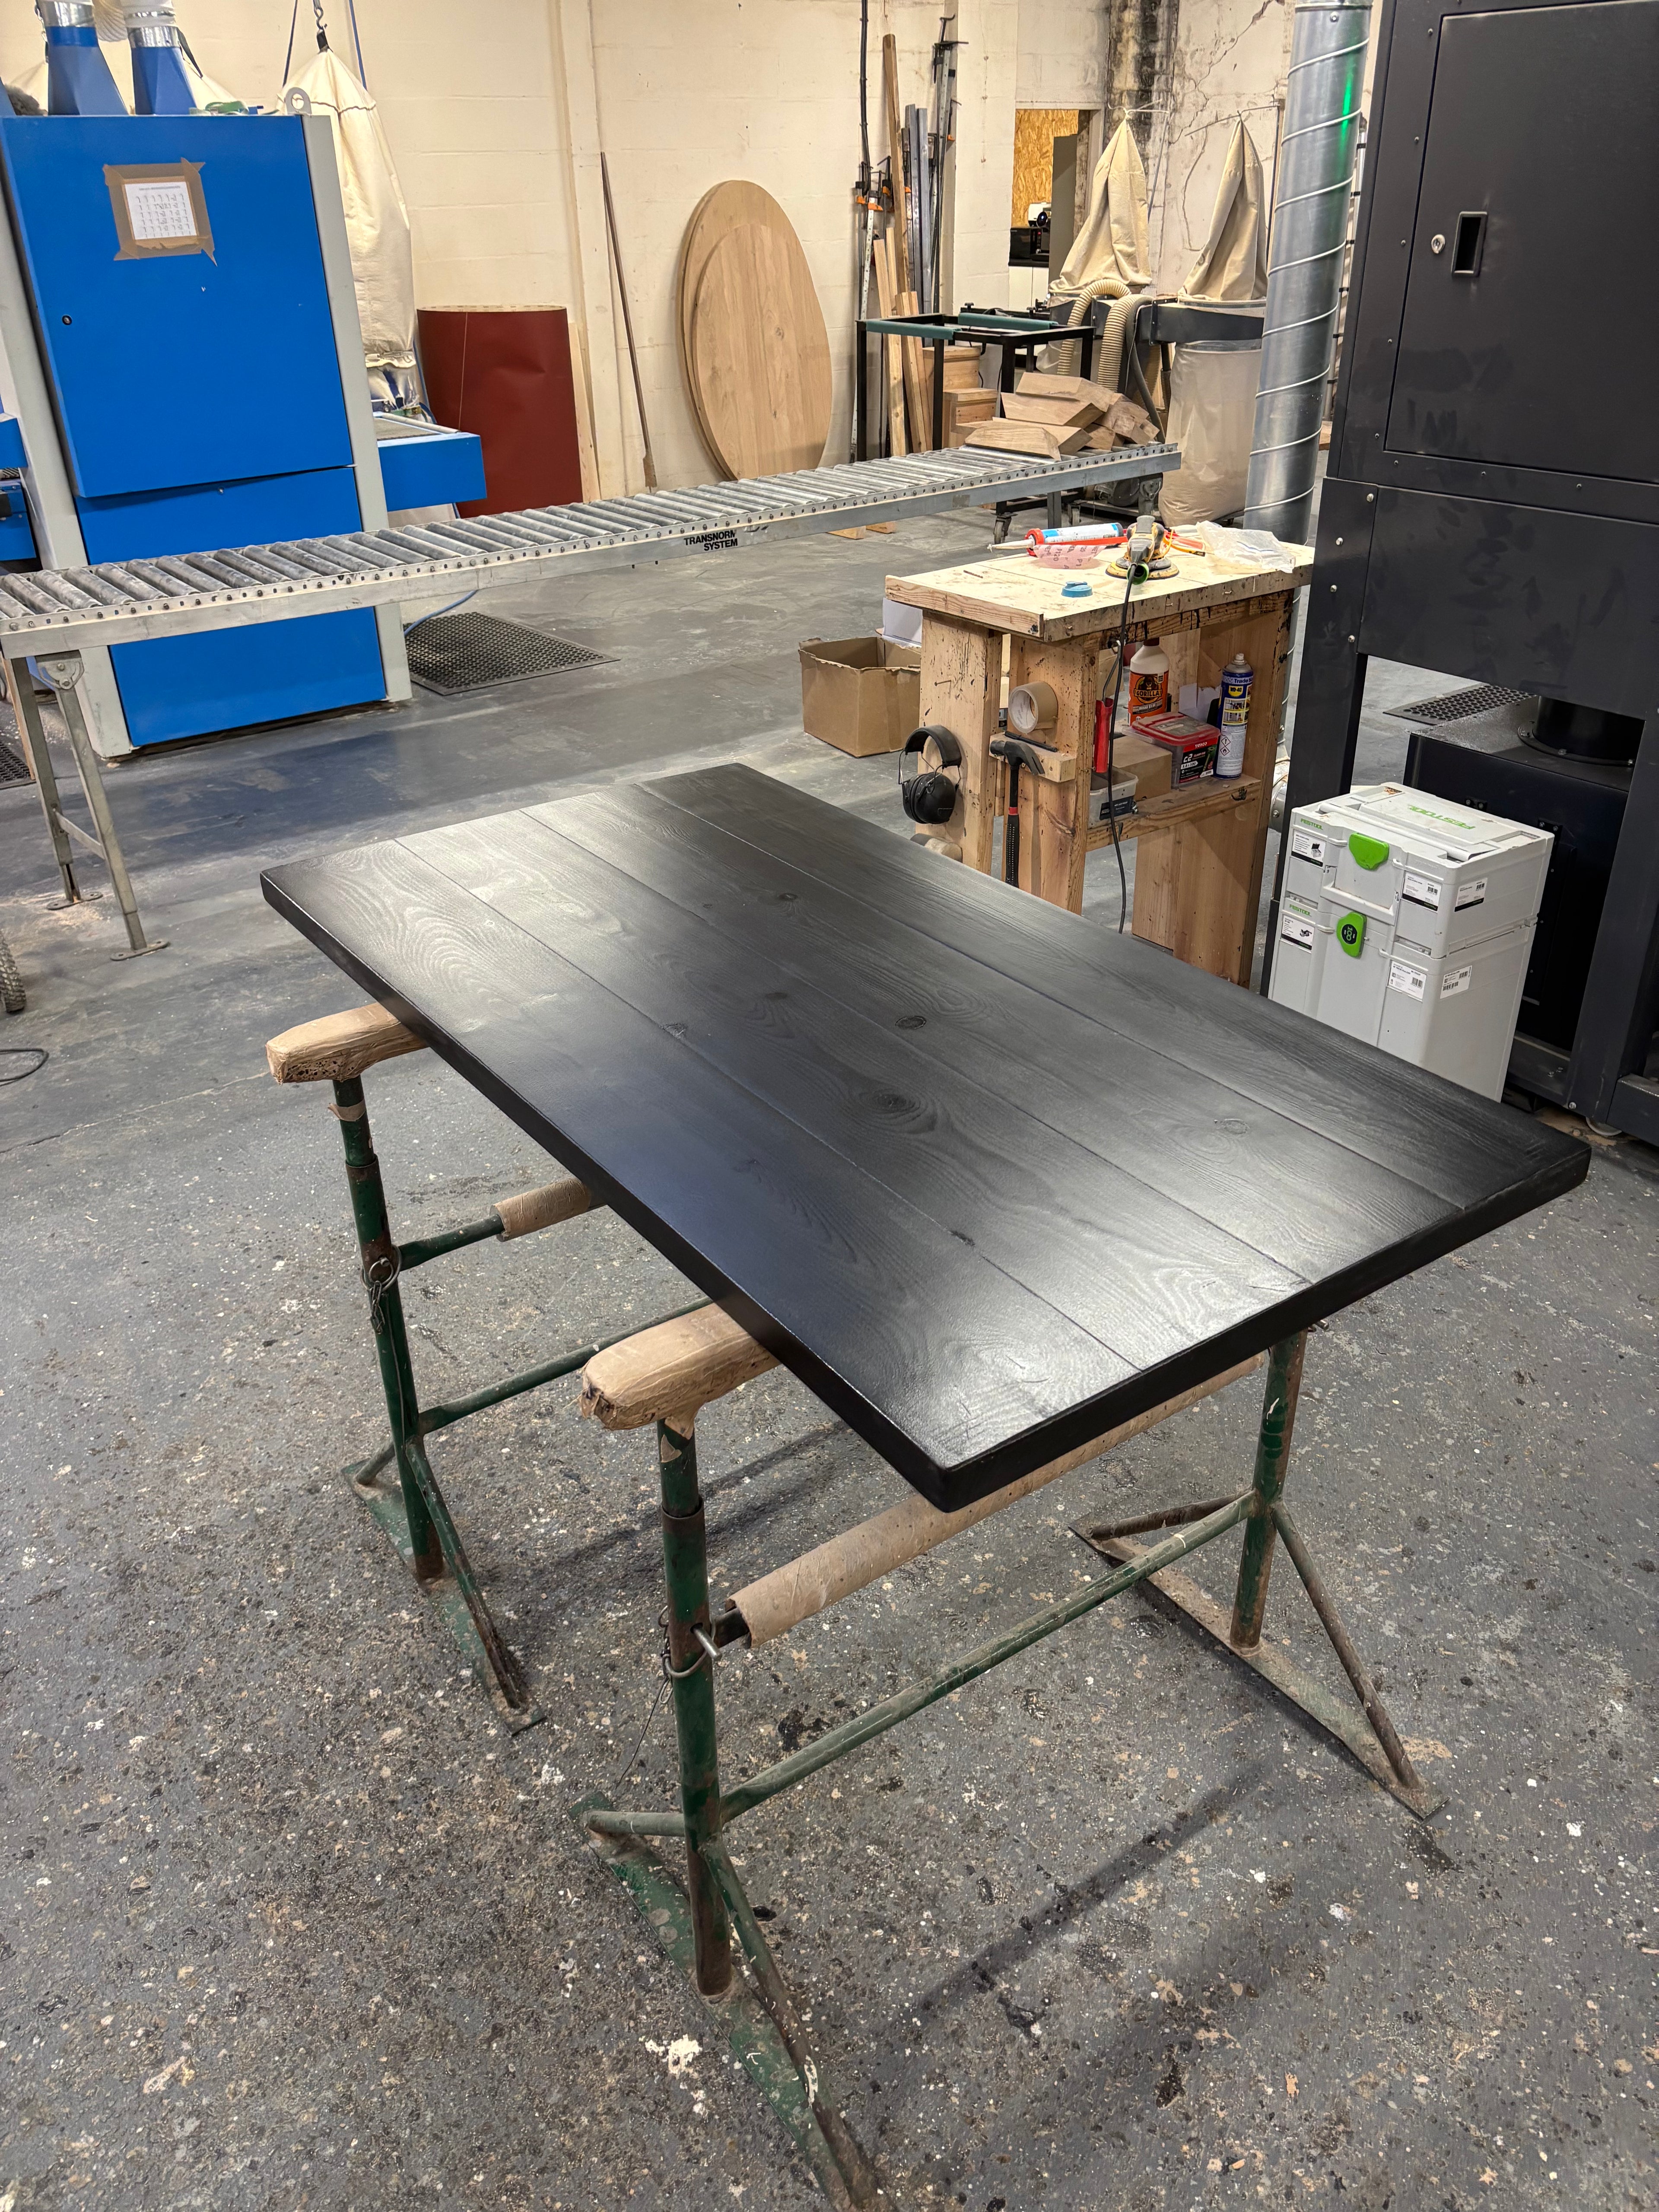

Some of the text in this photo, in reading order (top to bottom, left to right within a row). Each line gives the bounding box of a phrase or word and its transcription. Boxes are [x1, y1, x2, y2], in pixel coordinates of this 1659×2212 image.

[704, 538, 738, 551] SYSTEM
[1183, 753, 1193, 763] C2
[1408, 804, 1476, 830] FESTOOL
[1300, 818, 1323, 830] FESTOOL
[1290, 904, 1312, 917] FESTOOL
